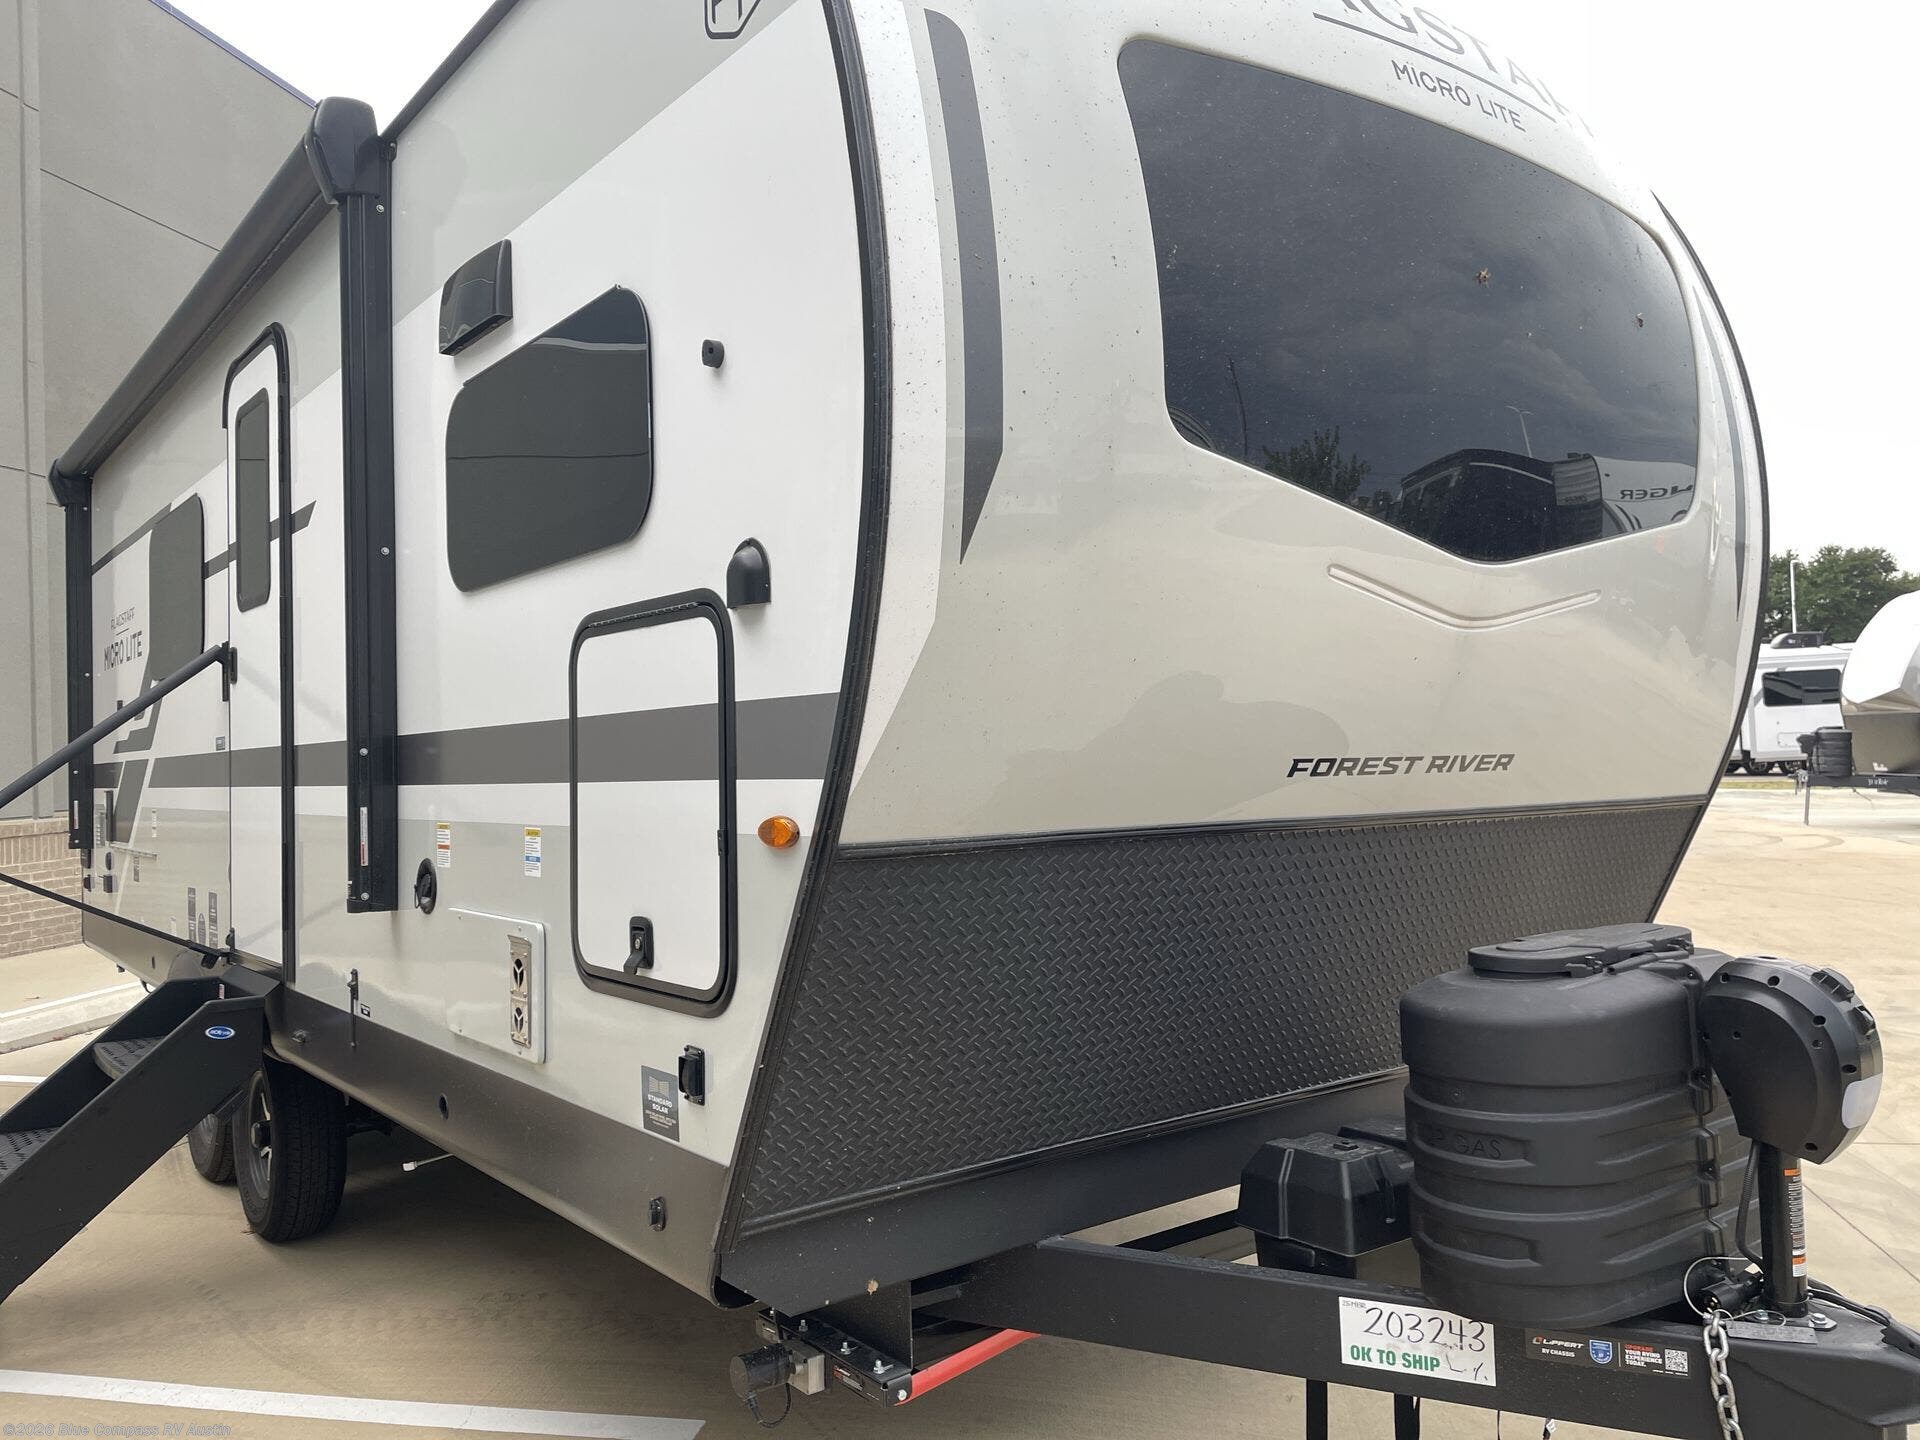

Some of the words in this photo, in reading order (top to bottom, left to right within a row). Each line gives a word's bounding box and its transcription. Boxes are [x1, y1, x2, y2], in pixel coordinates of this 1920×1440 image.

[1391, 60, 1471, 107] MICRO
[1476, 94, 1527, 132] LITE
[104, 640, 125, 671] MICRO
[125, 630, 142, 662] LITE
[1286, 756, 1424, 778] FOREST
[1425, 753, 1515, 774] RIVER
[647, 1094, 673, 1108] STANDARD
[652, 1103, 669, 1114] SOLAR
[1454, 1134, 1502, 1159] GAS
[1364, 1307, 1486, 1351] 203243
[1542, 1338, 1584, 1349] LIPPERT
[1550, 1349, 1576, 1358] CHASSIS
[1350, 1344, 1373, 1362] OK
[1376, 1349, 1397, 1366] TO
[1401, 1352, 1441, 1372] SHIP
[1625, 1354, 1663, 1364] EXPERIENCE
